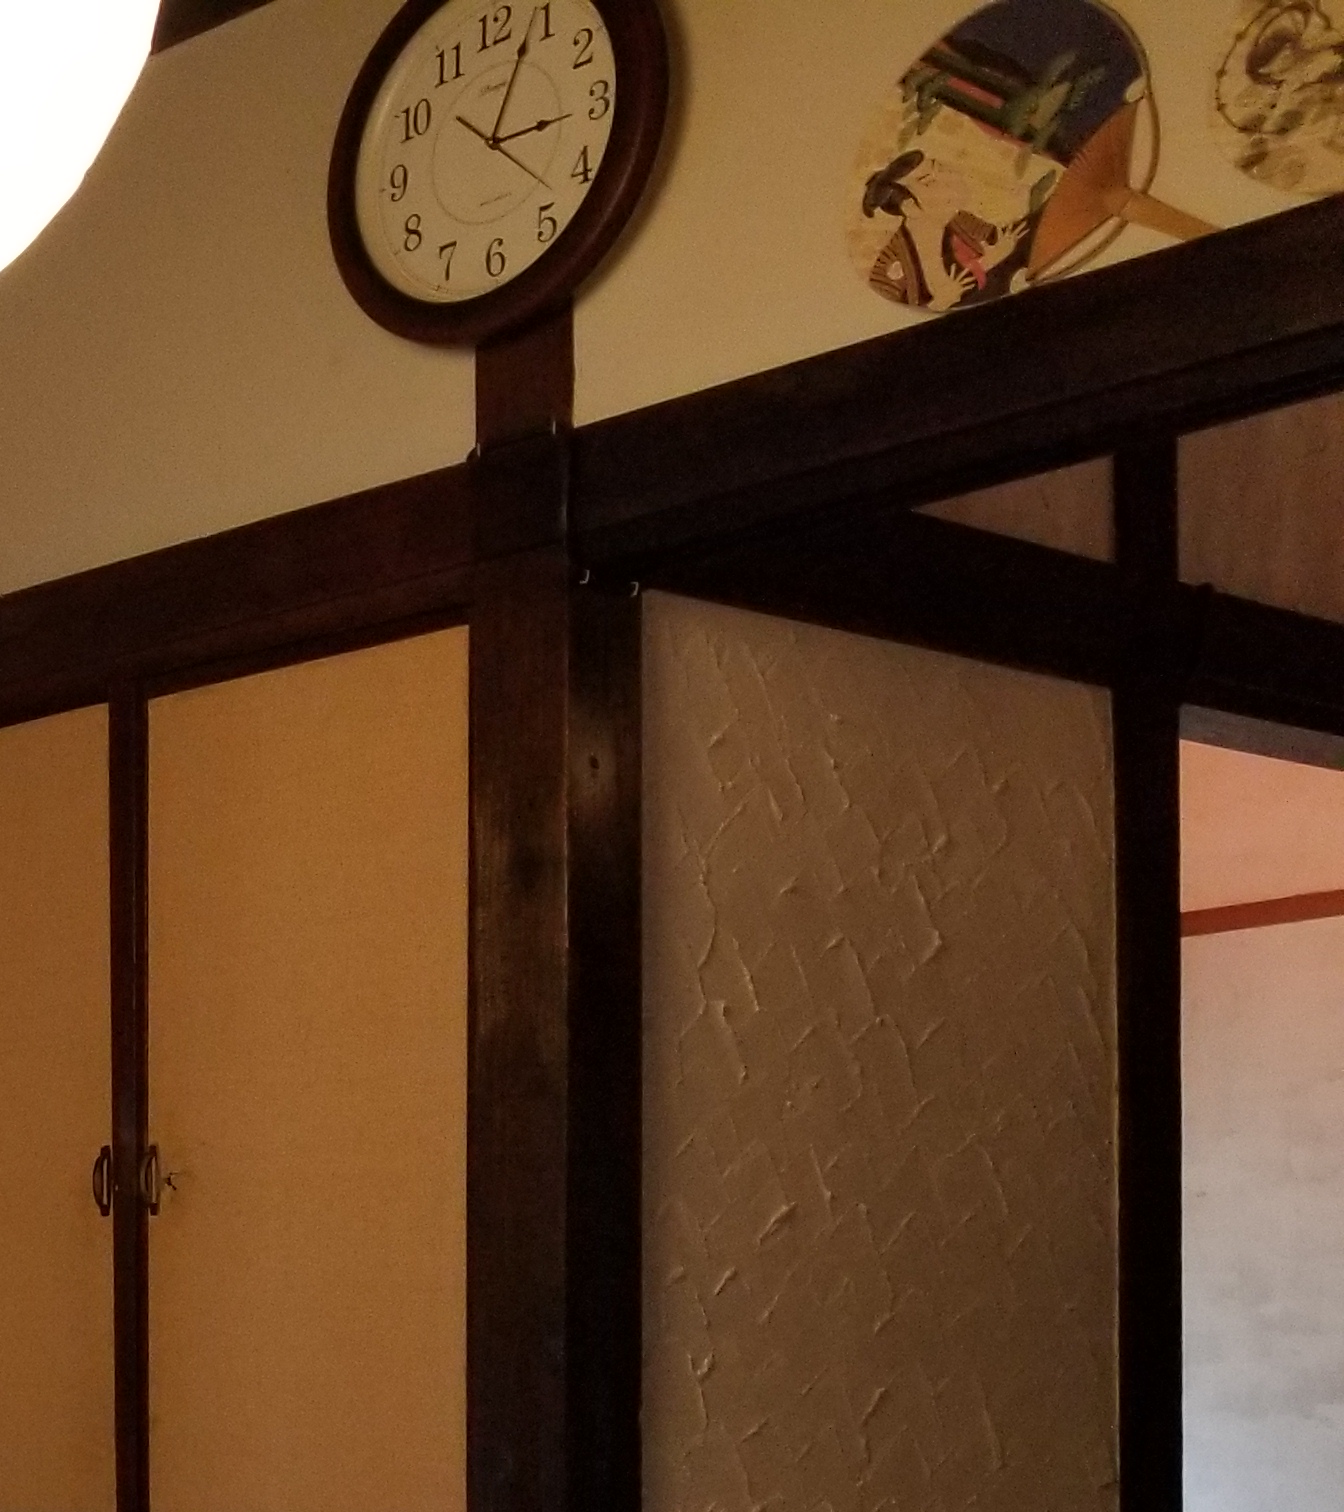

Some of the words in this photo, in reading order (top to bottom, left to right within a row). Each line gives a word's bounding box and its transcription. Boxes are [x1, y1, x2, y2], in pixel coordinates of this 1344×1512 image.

[477, 5, 512, 53] 12
[540, 2, 555, 41] 1
[435, 42, 465, 88] 11
[573, 28, 593, 69] 2
[589, 80, 610, 120] 3
[401, 99, 431, 143] 10
[390, 164, 407, 202] 9
[571, 146, 593, 185] 4
[404, 214, 422, 251] 8
[538, 202, 557, 243] 5
[439, 241, 457, 281] 7
[486, 238, 505, 277] 6
